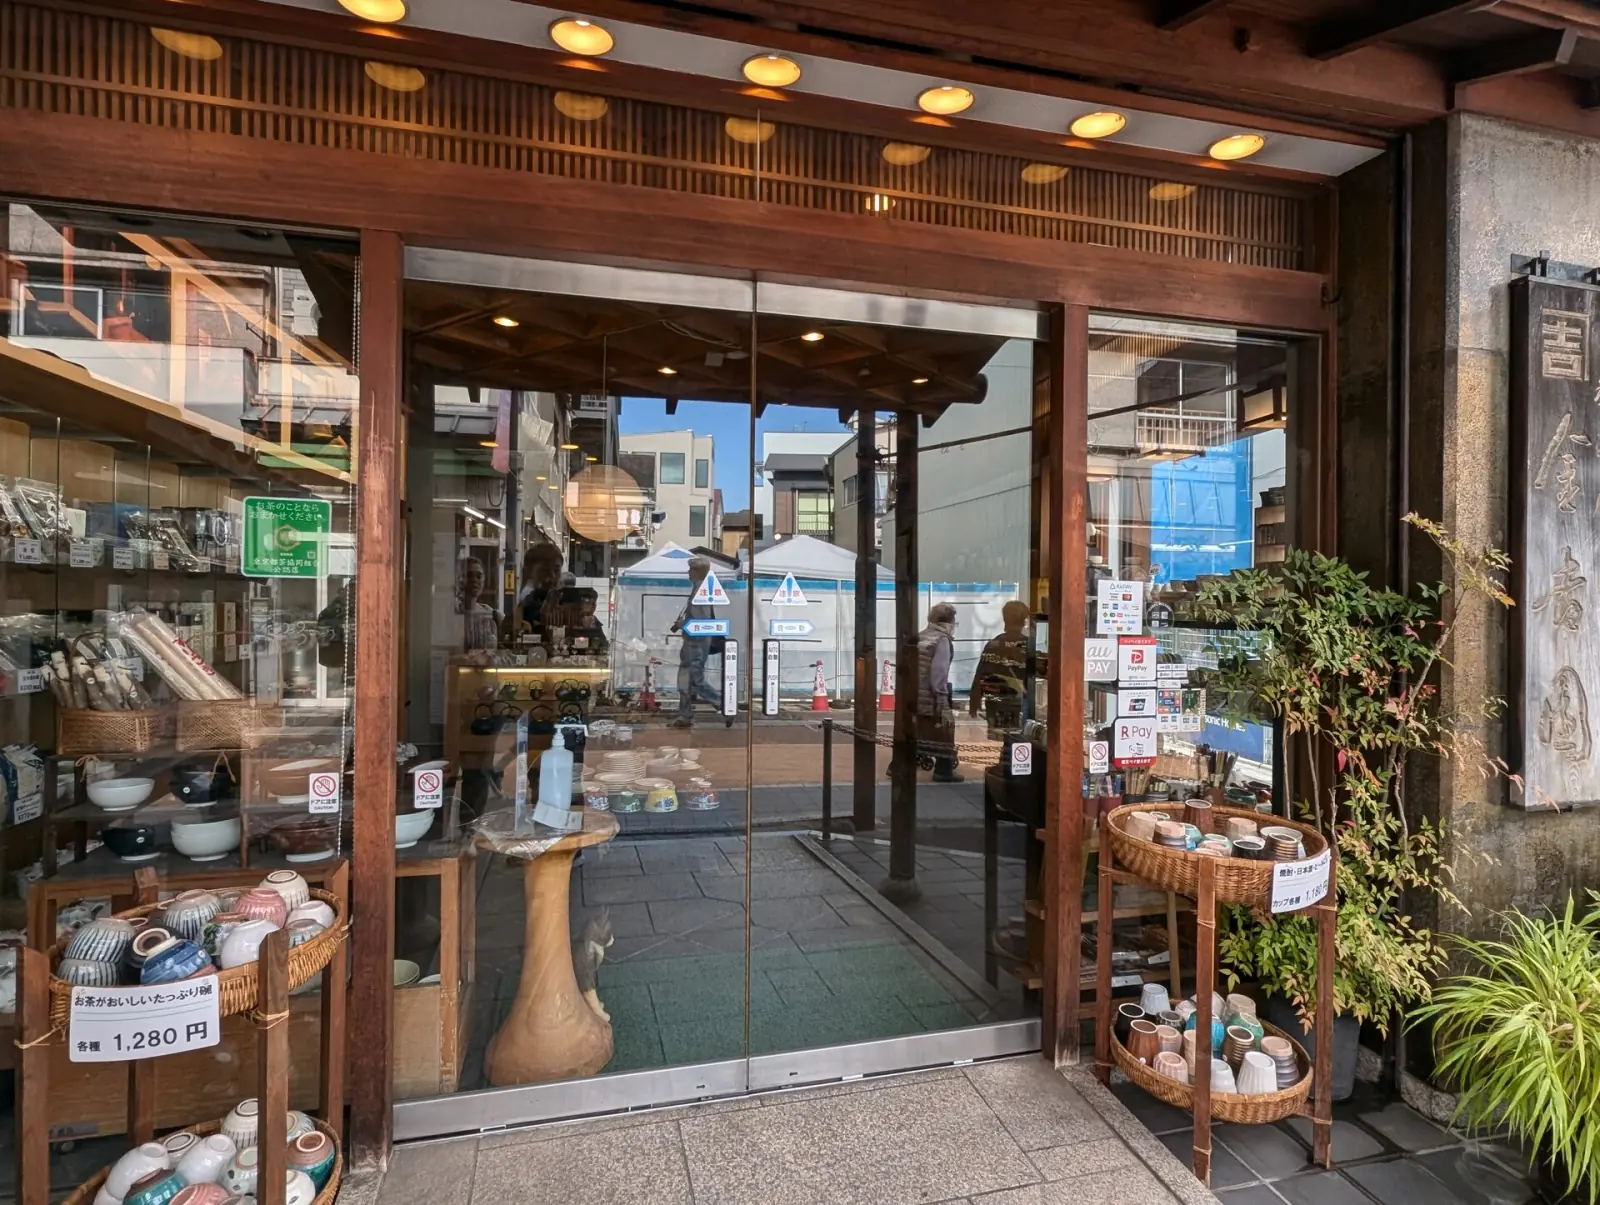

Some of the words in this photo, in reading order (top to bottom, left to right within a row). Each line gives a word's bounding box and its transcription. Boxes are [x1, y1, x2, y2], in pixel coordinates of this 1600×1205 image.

[256, 502, 320, 512] お茶のことなら
[1087, 644, 1112, 658] au
[1087, 661, 1112, 675] PAY
[1127, 664, 1148, 672] PayPay
[1131, 725, 1152, 739] Pay
[74, 984, 213, 1008] お茶がおいしいたっぷり碗
[76, 1040, 102, 1053] 各種
[113, 1027, 178, 1052] 1,280
[186, 1021, 208, 1043] 円
